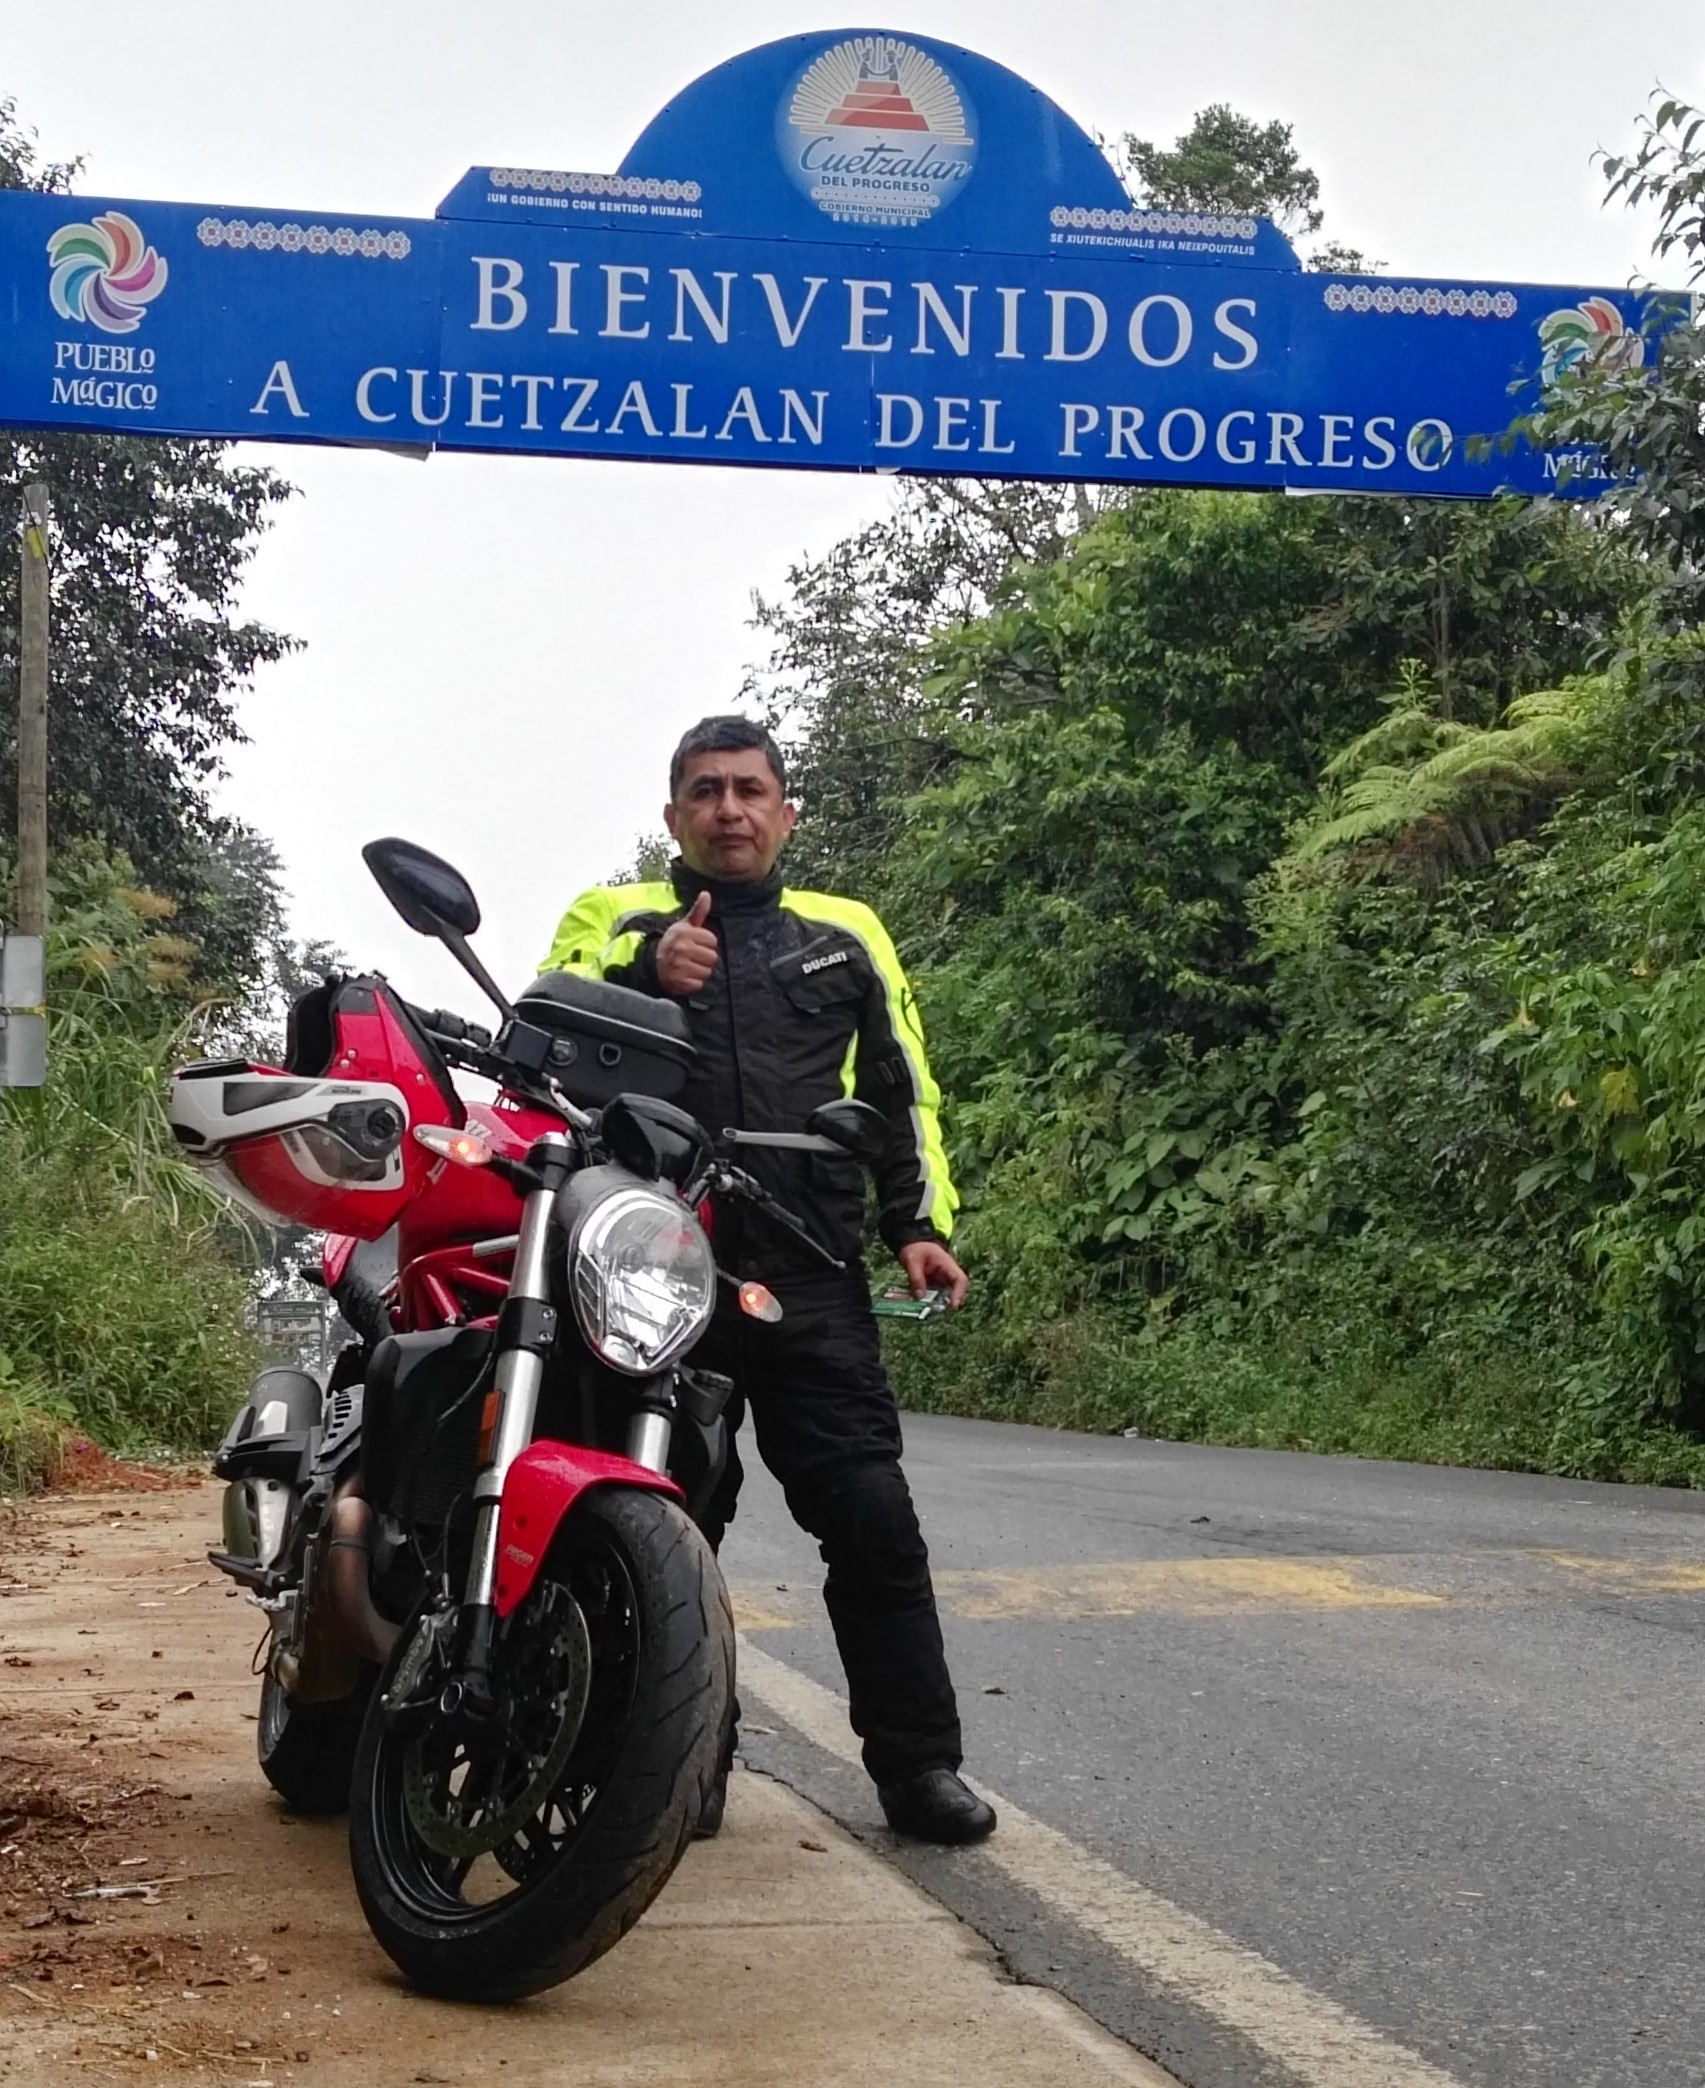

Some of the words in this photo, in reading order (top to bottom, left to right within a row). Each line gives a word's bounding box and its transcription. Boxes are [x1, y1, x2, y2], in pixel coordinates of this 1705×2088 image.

[800, 136, 972, 181] Cuetzalan
[821, 175, 848, 187] DEL
[851, 178, 930, 193] PROGRESO
[511, 195, 568, 209] GOBIERNO
[572, 199, 596, 210] CON
[599, 202, 647, 215] SENTIDO
[820, 202, 873, 213] GOBIERNO
[875, 206, 930, 218] MUNICIPAL
[1050, 233, 1064, 243] SE
[1158, 240, 1175, 250] IKA
[470, 256, 1258, 370] BIENVENIDOS
[249, 359, 310, 418] A
[356, 366, 829, 446] CUETZALAN
[875, 393, 1015, 454] DEL
[1058, 403, 1453, 472] PROGRESO
[802, 951, 848, 974] DUCATI
